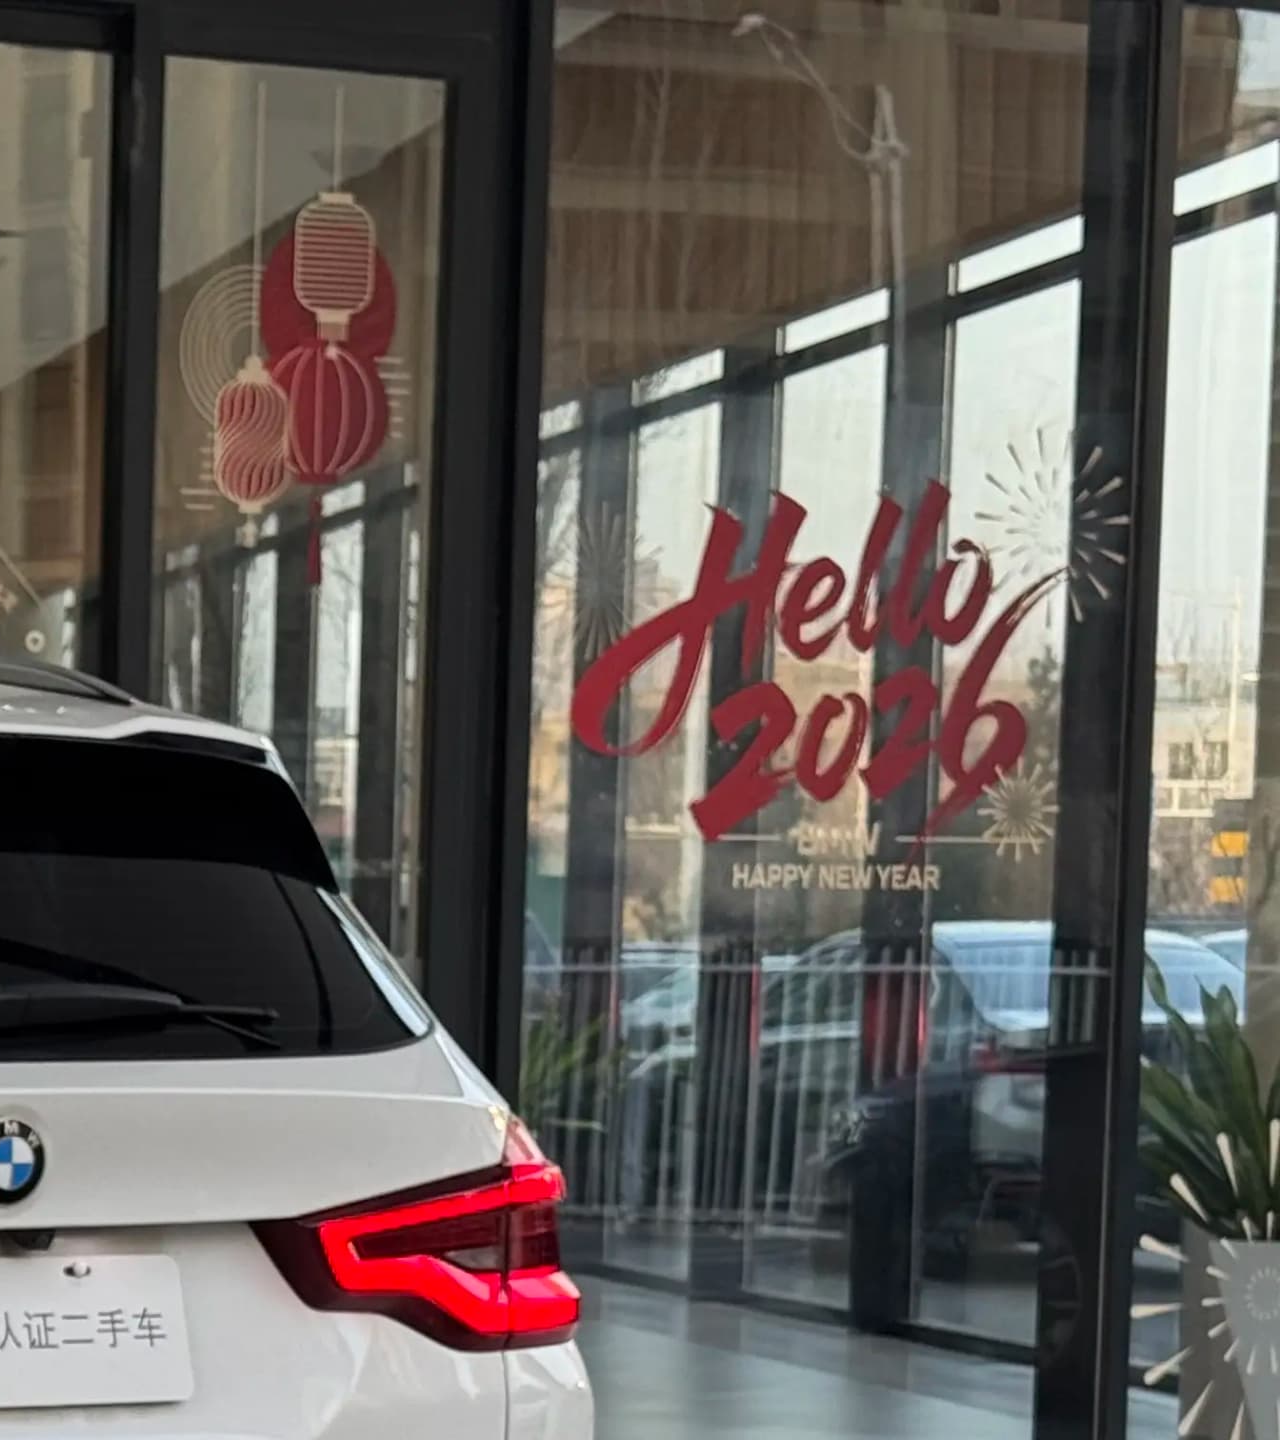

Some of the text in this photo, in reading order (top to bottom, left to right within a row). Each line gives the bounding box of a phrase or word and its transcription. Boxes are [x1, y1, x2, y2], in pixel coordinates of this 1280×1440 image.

[570, 477, 995, 757] Hello
[689, 566, 1074, 850] 2026
[732, 862, 940, 890] HAPPY NEW YEAR
